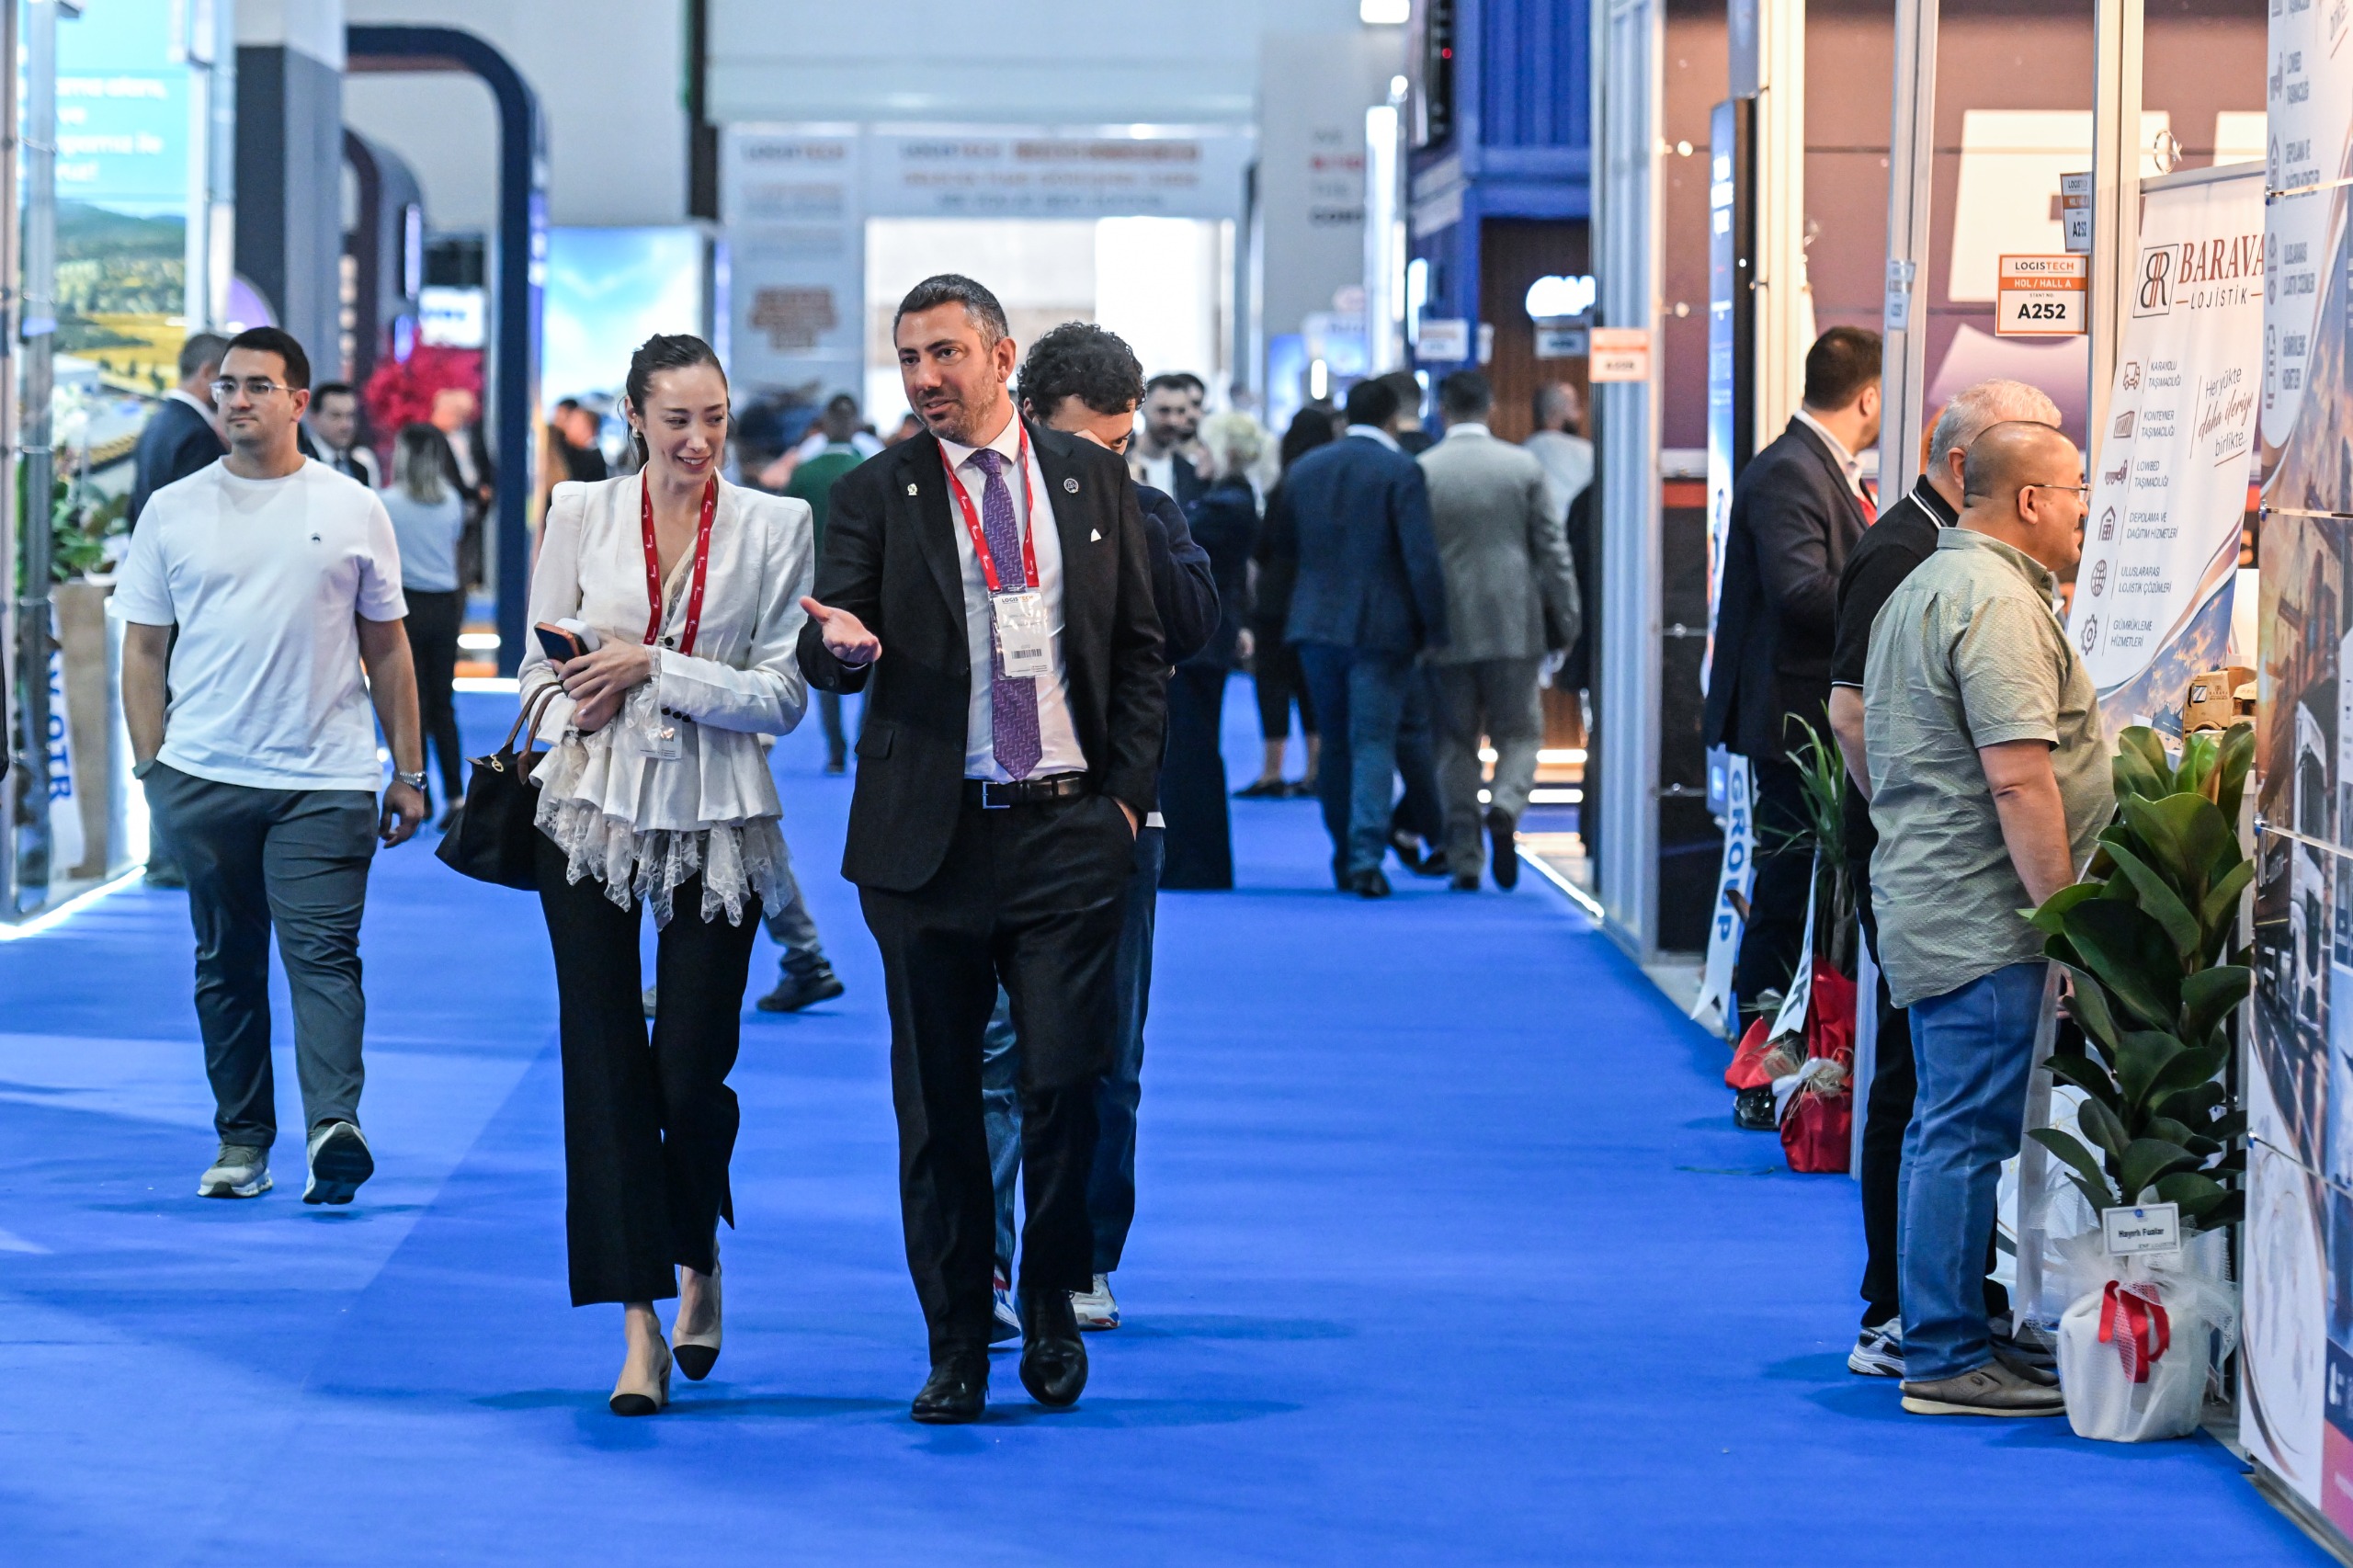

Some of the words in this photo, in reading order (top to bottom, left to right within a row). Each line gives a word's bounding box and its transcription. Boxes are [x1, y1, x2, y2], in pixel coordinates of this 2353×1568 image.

[2073, 221, 2087, 237] A252
[2178, 233, 2264, 284] BARAVA
[2015, 261, 2074, 270] LOGISTECH
[2014, 278, 2031, 288] HOL
[2040, 278, 2063, 288] HALL
[2064, 278, 2072, 288] A
[2190, 284, 2247, 310] LOJİSTİK
[2018, 303, 2066, 319] A252
[2151, 361, 2177, 371] KARAYOLU
[2148, 374, 2181, 390] TAŞIMACILIĞI
[2206, 380, 2219, 399] Her
[2219, 368, 2242, 396] yükte
[2143, 410, 2175, 421] KONTEYNER
[2199, 401, 2222, 443] daha
[2142, 425, 2176, 439] TAŞIMACILIĞI
[2137, 460, 2160, 472] LOWBED
[2134, 475, 2169, 490] TAŞIMACILIĞI
[2129, 512, 2159, 523] DEPOLAMA
[2160, 512, 2167, 522] VE
[2127, 527, 2151, 539] DAĞITIM
[2120, 566, 2160, 577] ULUSLARARASI
[2113, 619, 2153, 631] GÜMRÜKLEME
[2110, 634, 2143, 647] HİZMETLERİ
[1718, 769, 1745, 943] GROUP
